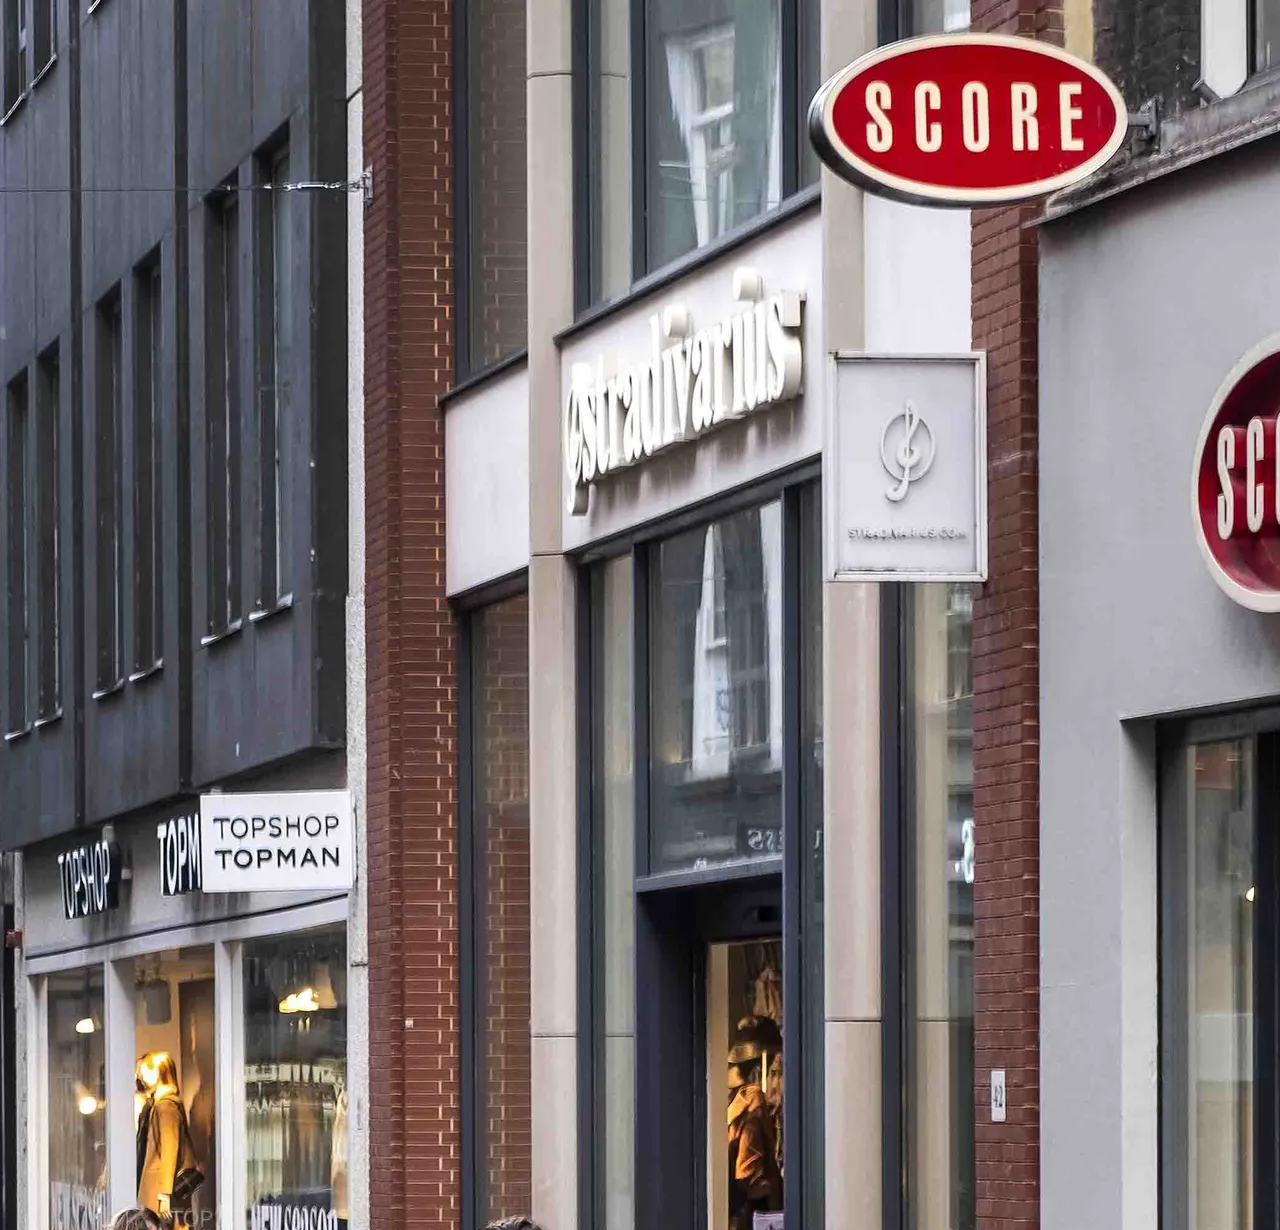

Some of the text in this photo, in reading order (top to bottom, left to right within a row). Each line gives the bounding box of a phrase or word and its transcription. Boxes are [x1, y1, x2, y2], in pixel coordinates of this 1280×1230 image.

[864, 79, 1085, 153] SCORE
[573, 268, 806, 490] stradivarius
[213, 815, 340, 839] TOPSHOP
[214, 846, 341, 870] TOPMAN
[57, 839, 111, 920] TOPSHOP
